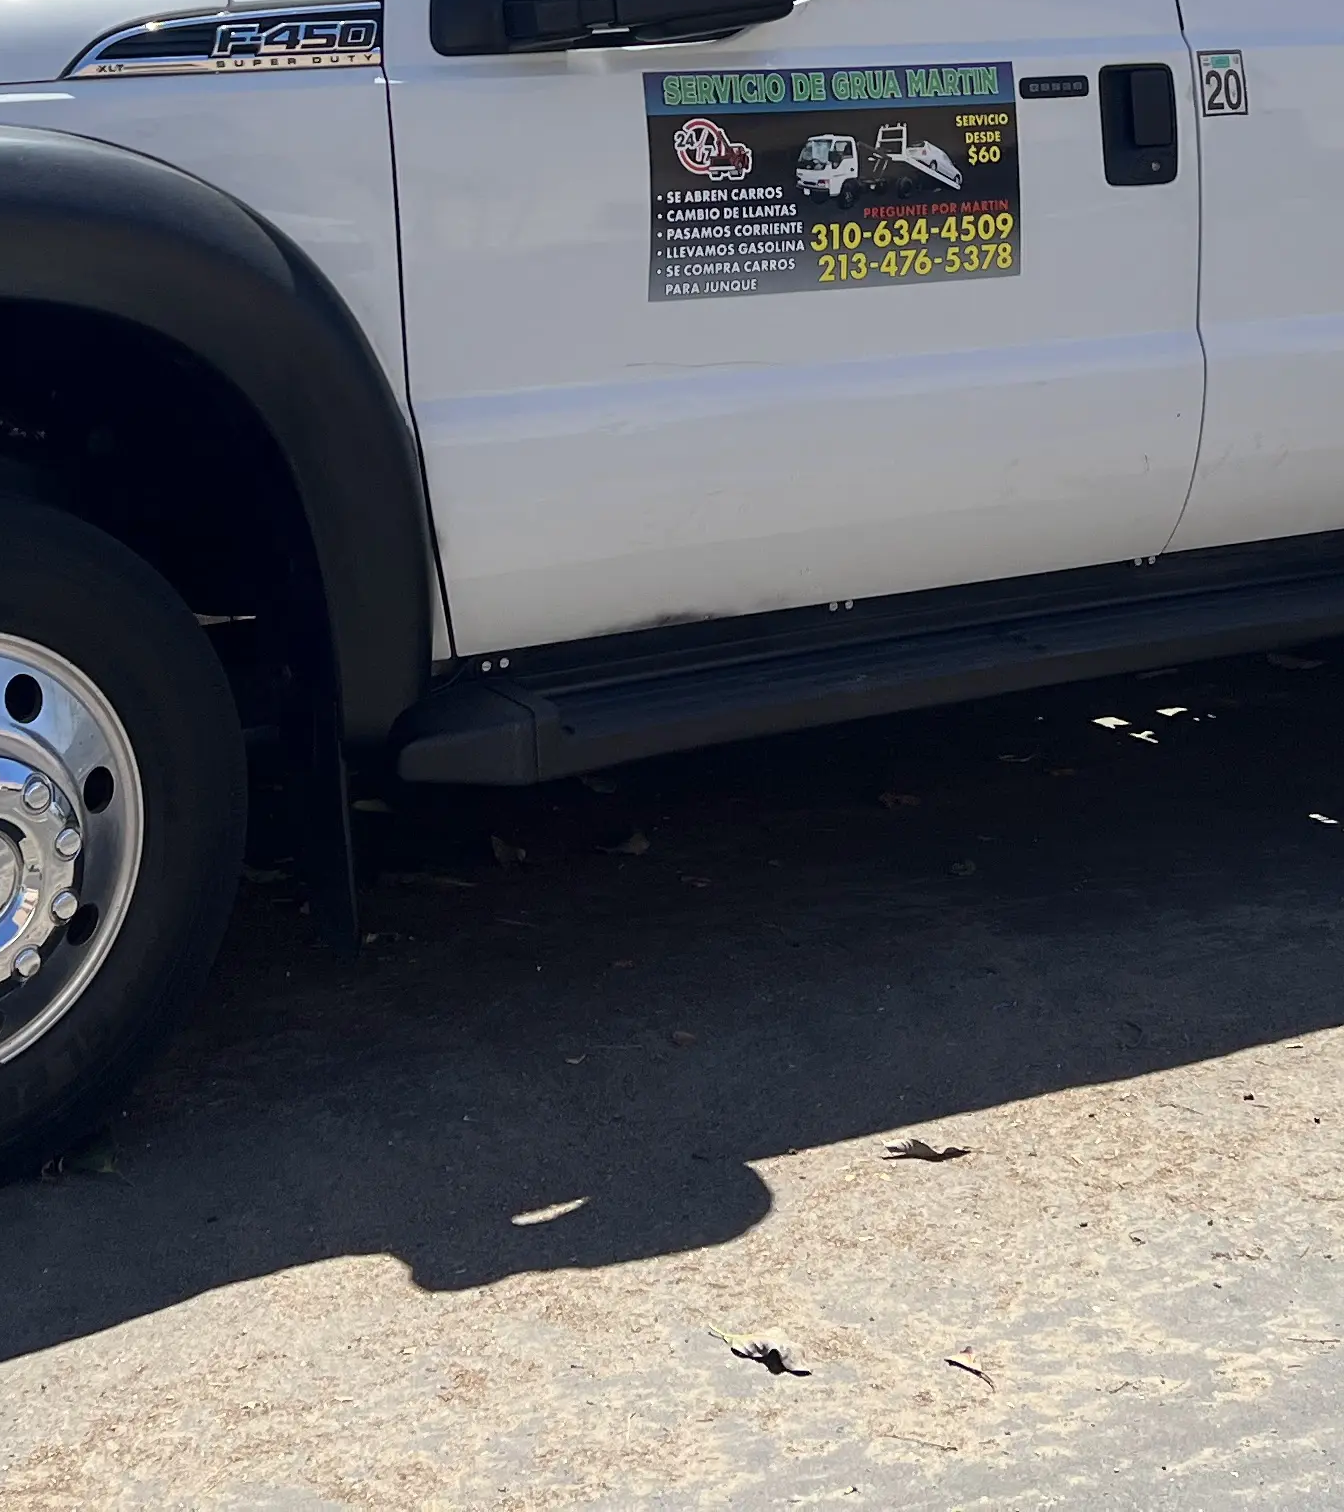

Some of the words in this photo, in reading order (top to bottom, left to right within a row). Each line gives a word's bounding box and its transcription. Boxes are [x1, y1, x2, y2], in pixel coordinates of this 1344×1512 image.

[211, 19, 378, 58] F-450
[96, 64, 124, 73] XLT
[216, 57, 296, 68] SUPER
[312, 54, 373, 64] DUTY
[662, 73, 786, 106] SERVICIO
[791, 72, 827, 102] DE
[831, 69, 903, 100] GRUA
[906, 66, 1000, 98] MARTIN
[1205, 69, 1242, 110] 20
[955, 113, 1009, 127] SERVICIO
[965, 131, 1001, 144] DESDE
[968, 145, 1001, 166] $60
[666, 191, 682, 204] SE
[684, 189, 728, 203] ABREN
[731, 186, 783, 201] CARROS
[666, 207, 720, 222] CAMBIO
[723, 206, 740, 219] DE
[742, 203, 797, 219] LLANTAS
[863, 204, 929, 219] PREGUNTE
[931, 202, 957, 215] POR
[960, 200, 1009, 213] MARTIN
[666, 225, 731, 241] PASAMOS
[734, 221, 803, 237] CORRIENTE
[810, 212, 1014, 252] 310-634-4509
[666, 243, 735, 259] LLEVAMOS
[738, 239, 805, 255] GASOLINA
[666, 265, 681, 278] SE
[683, 261, 741, 276] COMPRA
[743, 258, 796, 272] CARROS
[818, 242, 1013, 283] 213-476-5378
[665, 283, 700, 296] PARA
[703, 278, 758, 293] JUNQUE
